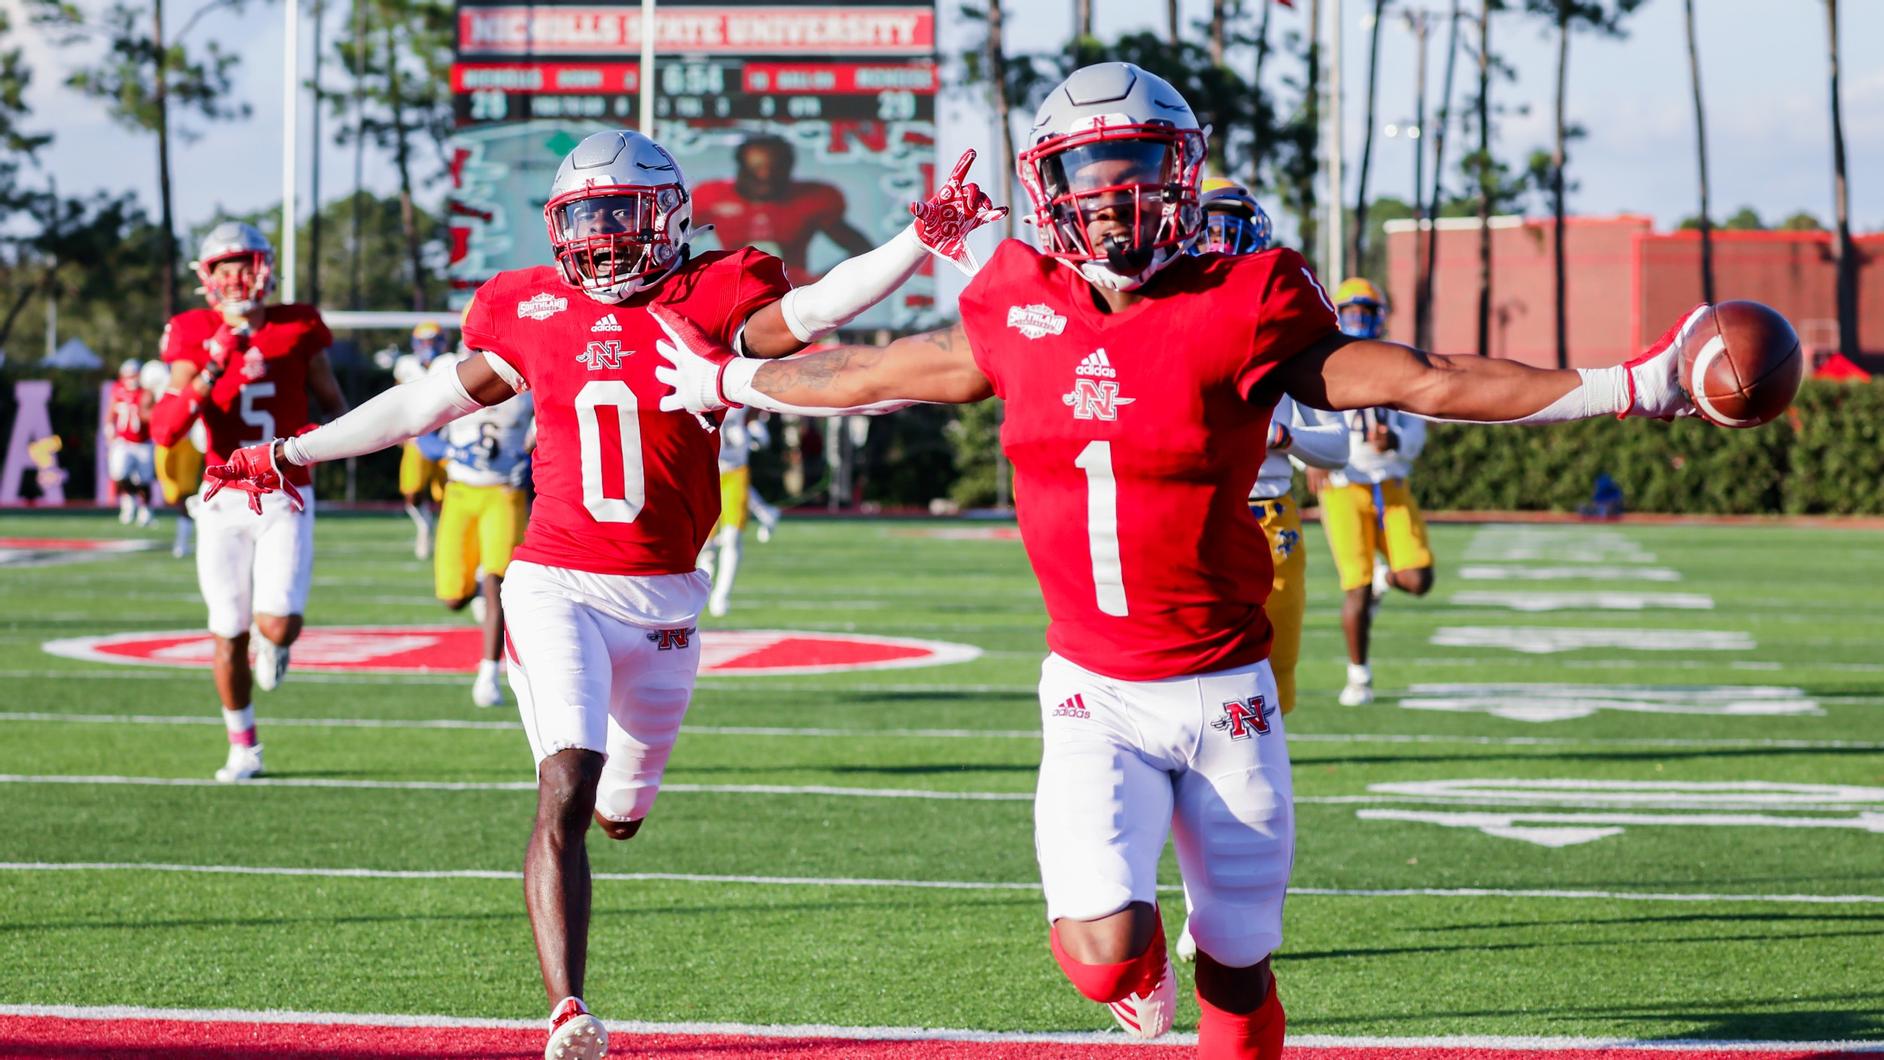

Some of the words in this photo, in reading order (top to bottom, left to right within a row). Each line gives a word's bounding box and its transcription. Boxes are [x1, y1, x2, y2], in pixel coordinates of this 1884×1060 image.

[727, 15, 916, 44] UNIVERSITY
[591, 324, 622, 333] adidas
[587, 340, 622, 371] N
[1075, 365, 1116, 378] adidas
[238, 381, 277, 450] 5
[1073, 378, 1120, 421] N
[574, 380, 646, 523] 0
[1074, 440, 1129, 617] 1
[1052, 707, 1091, 719] adidas
[1222, 695, 1271, 742] N
